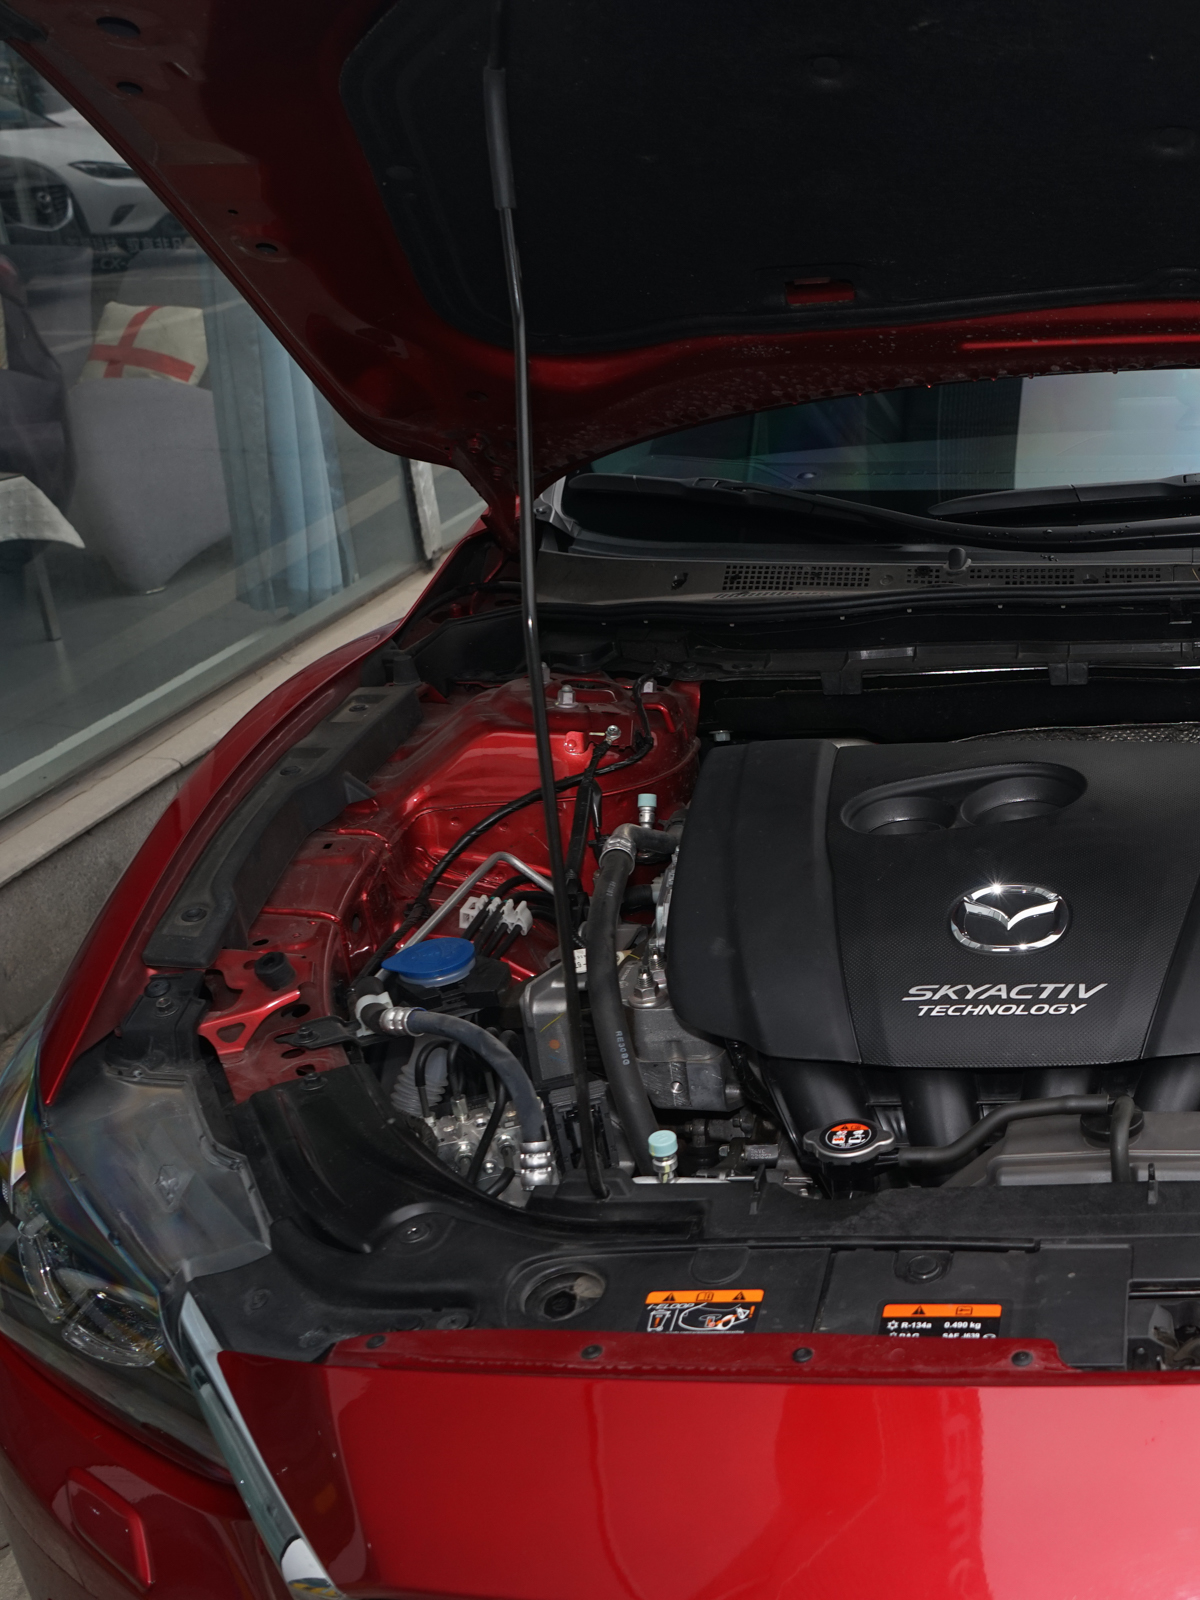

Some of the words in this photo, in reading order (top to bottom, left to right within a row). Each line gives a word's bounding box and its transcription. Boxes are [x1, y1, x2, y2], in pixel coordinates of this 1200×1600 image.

[901, 983, 1108, 1001] SKYACTIV
[917, 1003, 1087, 1017] TECHNOLOGY
[900, 1321, 932, 1329] R-134a
[943, 1321, 968, 1329] 0.490
[969, 1321, 982, 1330] kg
